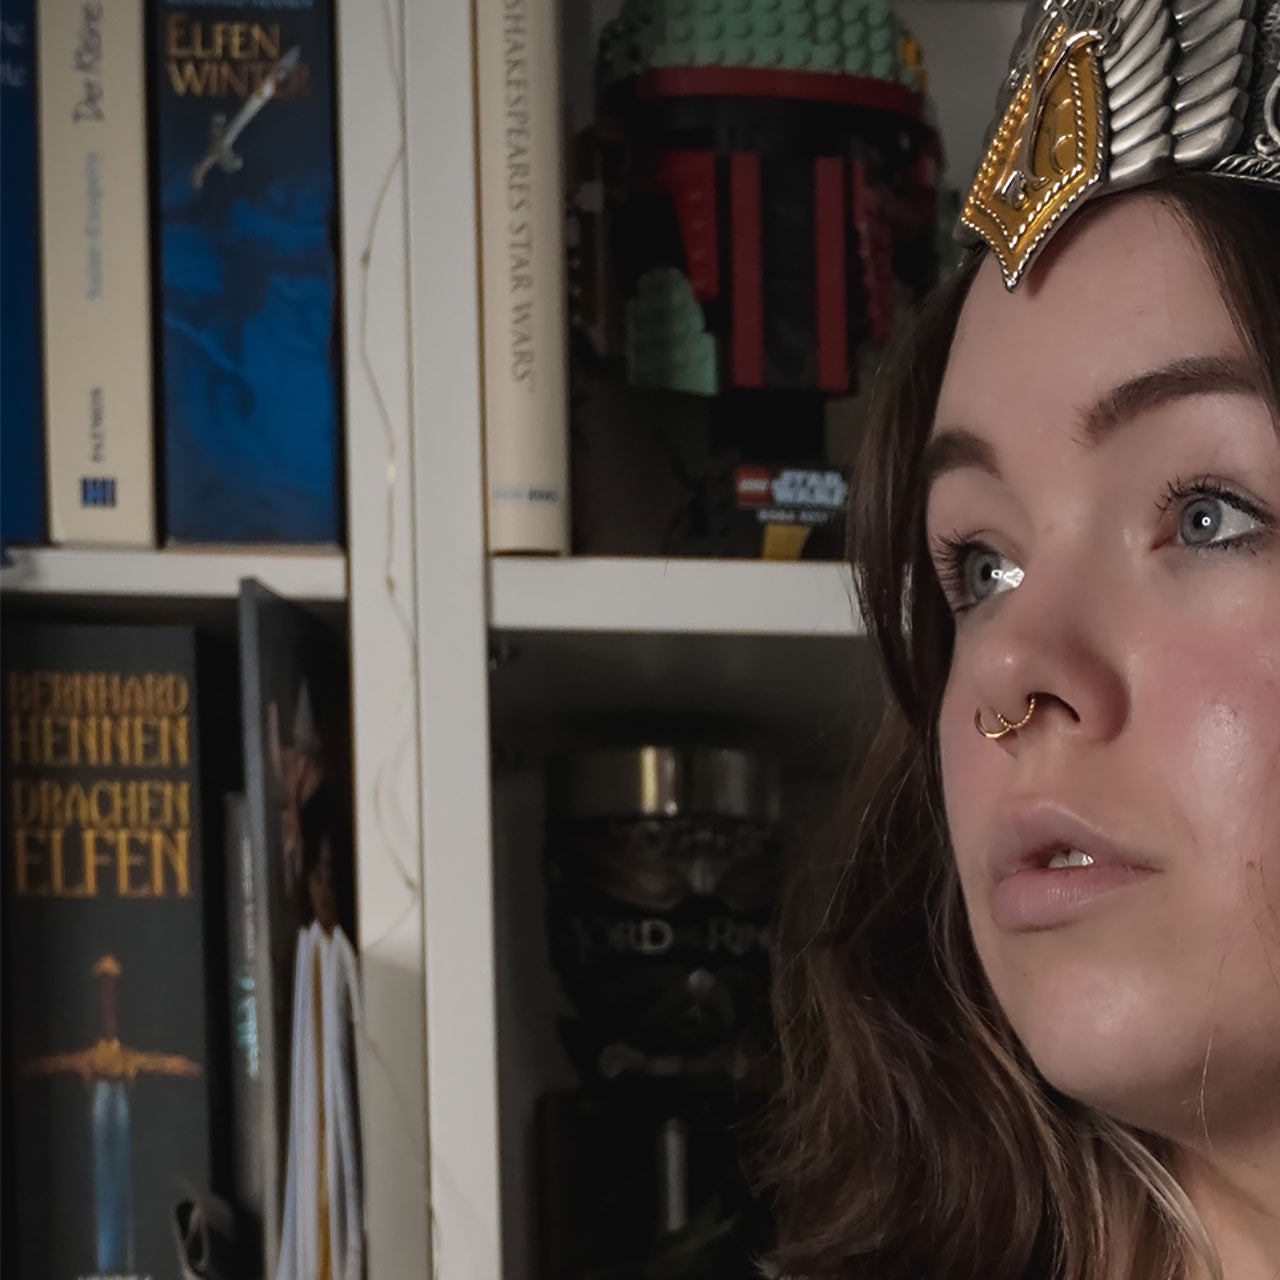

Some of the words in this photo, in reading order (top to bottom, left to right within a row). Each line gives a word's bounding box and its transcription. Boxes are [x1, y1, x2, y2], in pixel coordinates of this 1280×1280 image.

[165, 12, 281, 60] ELFEN
[508, 220, 535, 307] STAR
[9, 715, 190, 767] HENNEN
[14, 828, 191, 897] ELFEN
